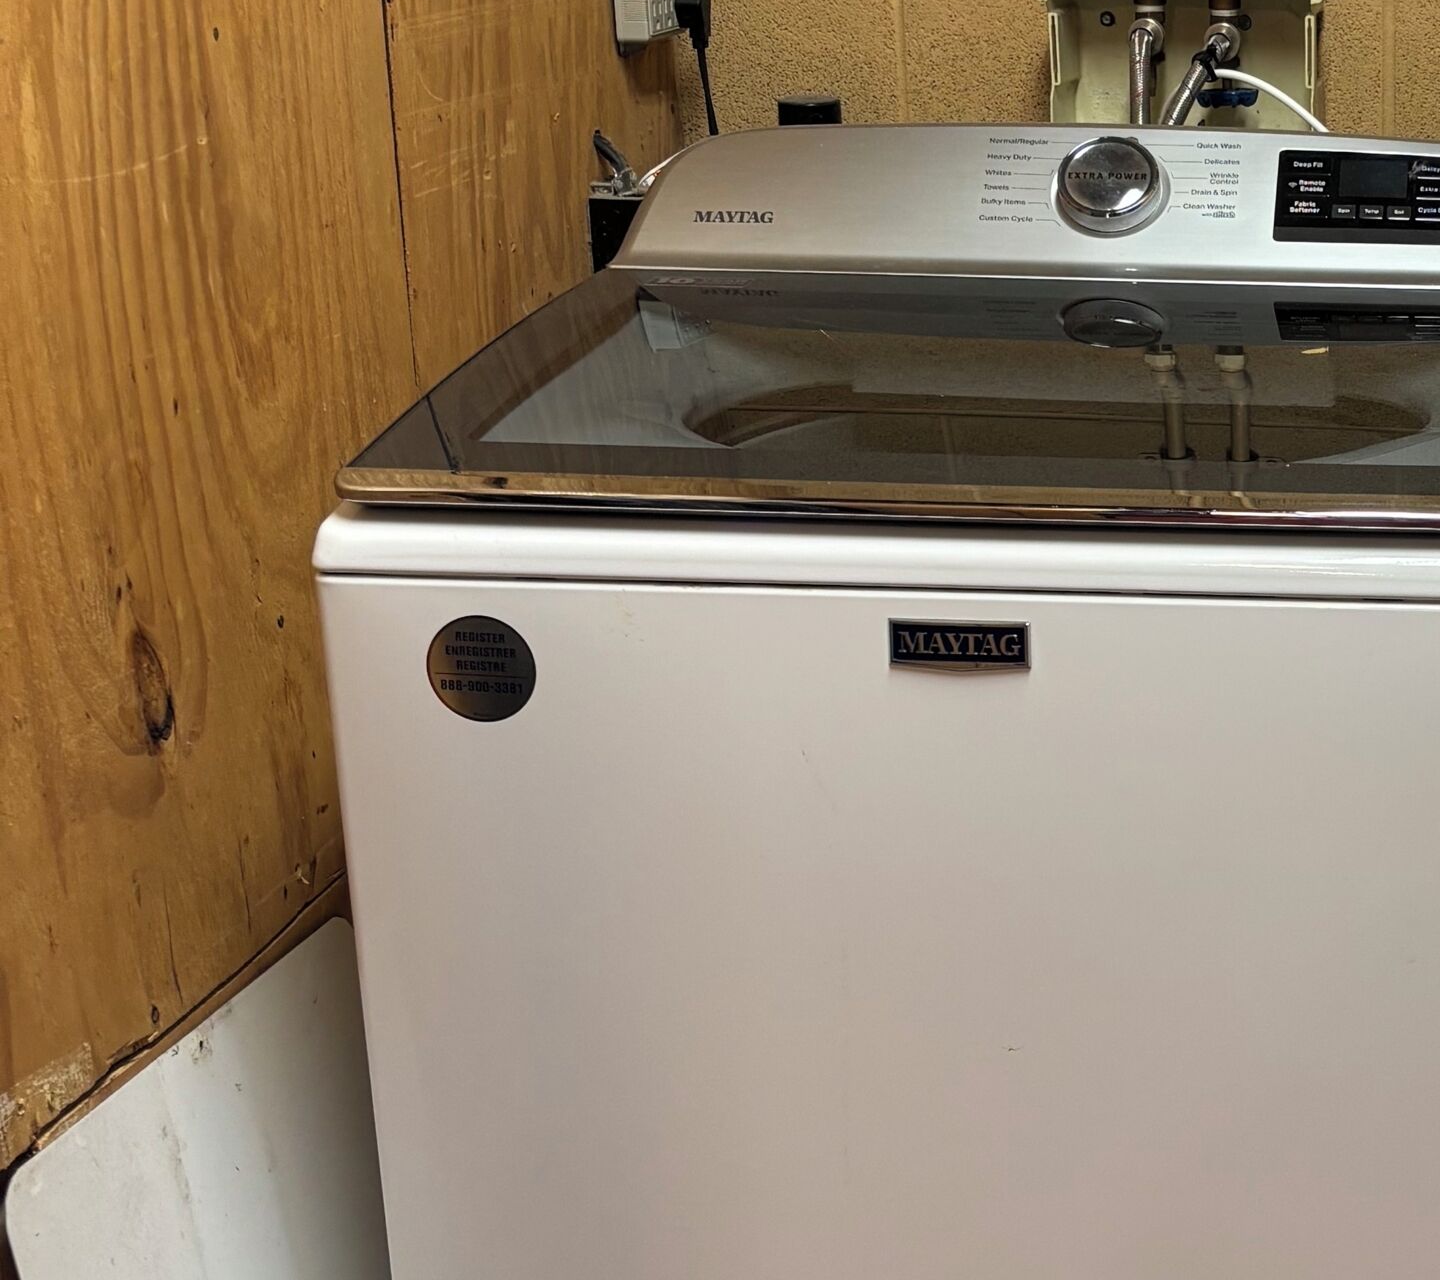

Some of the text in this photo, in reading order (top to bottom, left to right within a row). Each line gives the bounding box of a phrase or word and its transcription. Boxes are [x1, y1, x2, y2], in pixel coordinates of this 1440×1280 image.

[989, 137, 1049, 145] Normal/Regular
[1196, 142, 1218, 150] Quick
[987, 153, 1032, 162] Heavy Duty
[1293, 161, 1311, 169] Deep
[1067, 172, 1147, 181] EXTRA POWER
[1220, 189, 1238, 197] Spin
[693, 210, 774, 224] MAYTAG
[455, 631, 505, 644] REGISTER
[898, 631, 1021, 656] MAYTAG
[445, 645, 517, 659] ENREGISTRER
[456, 660, 507, 672] REGISTRE
